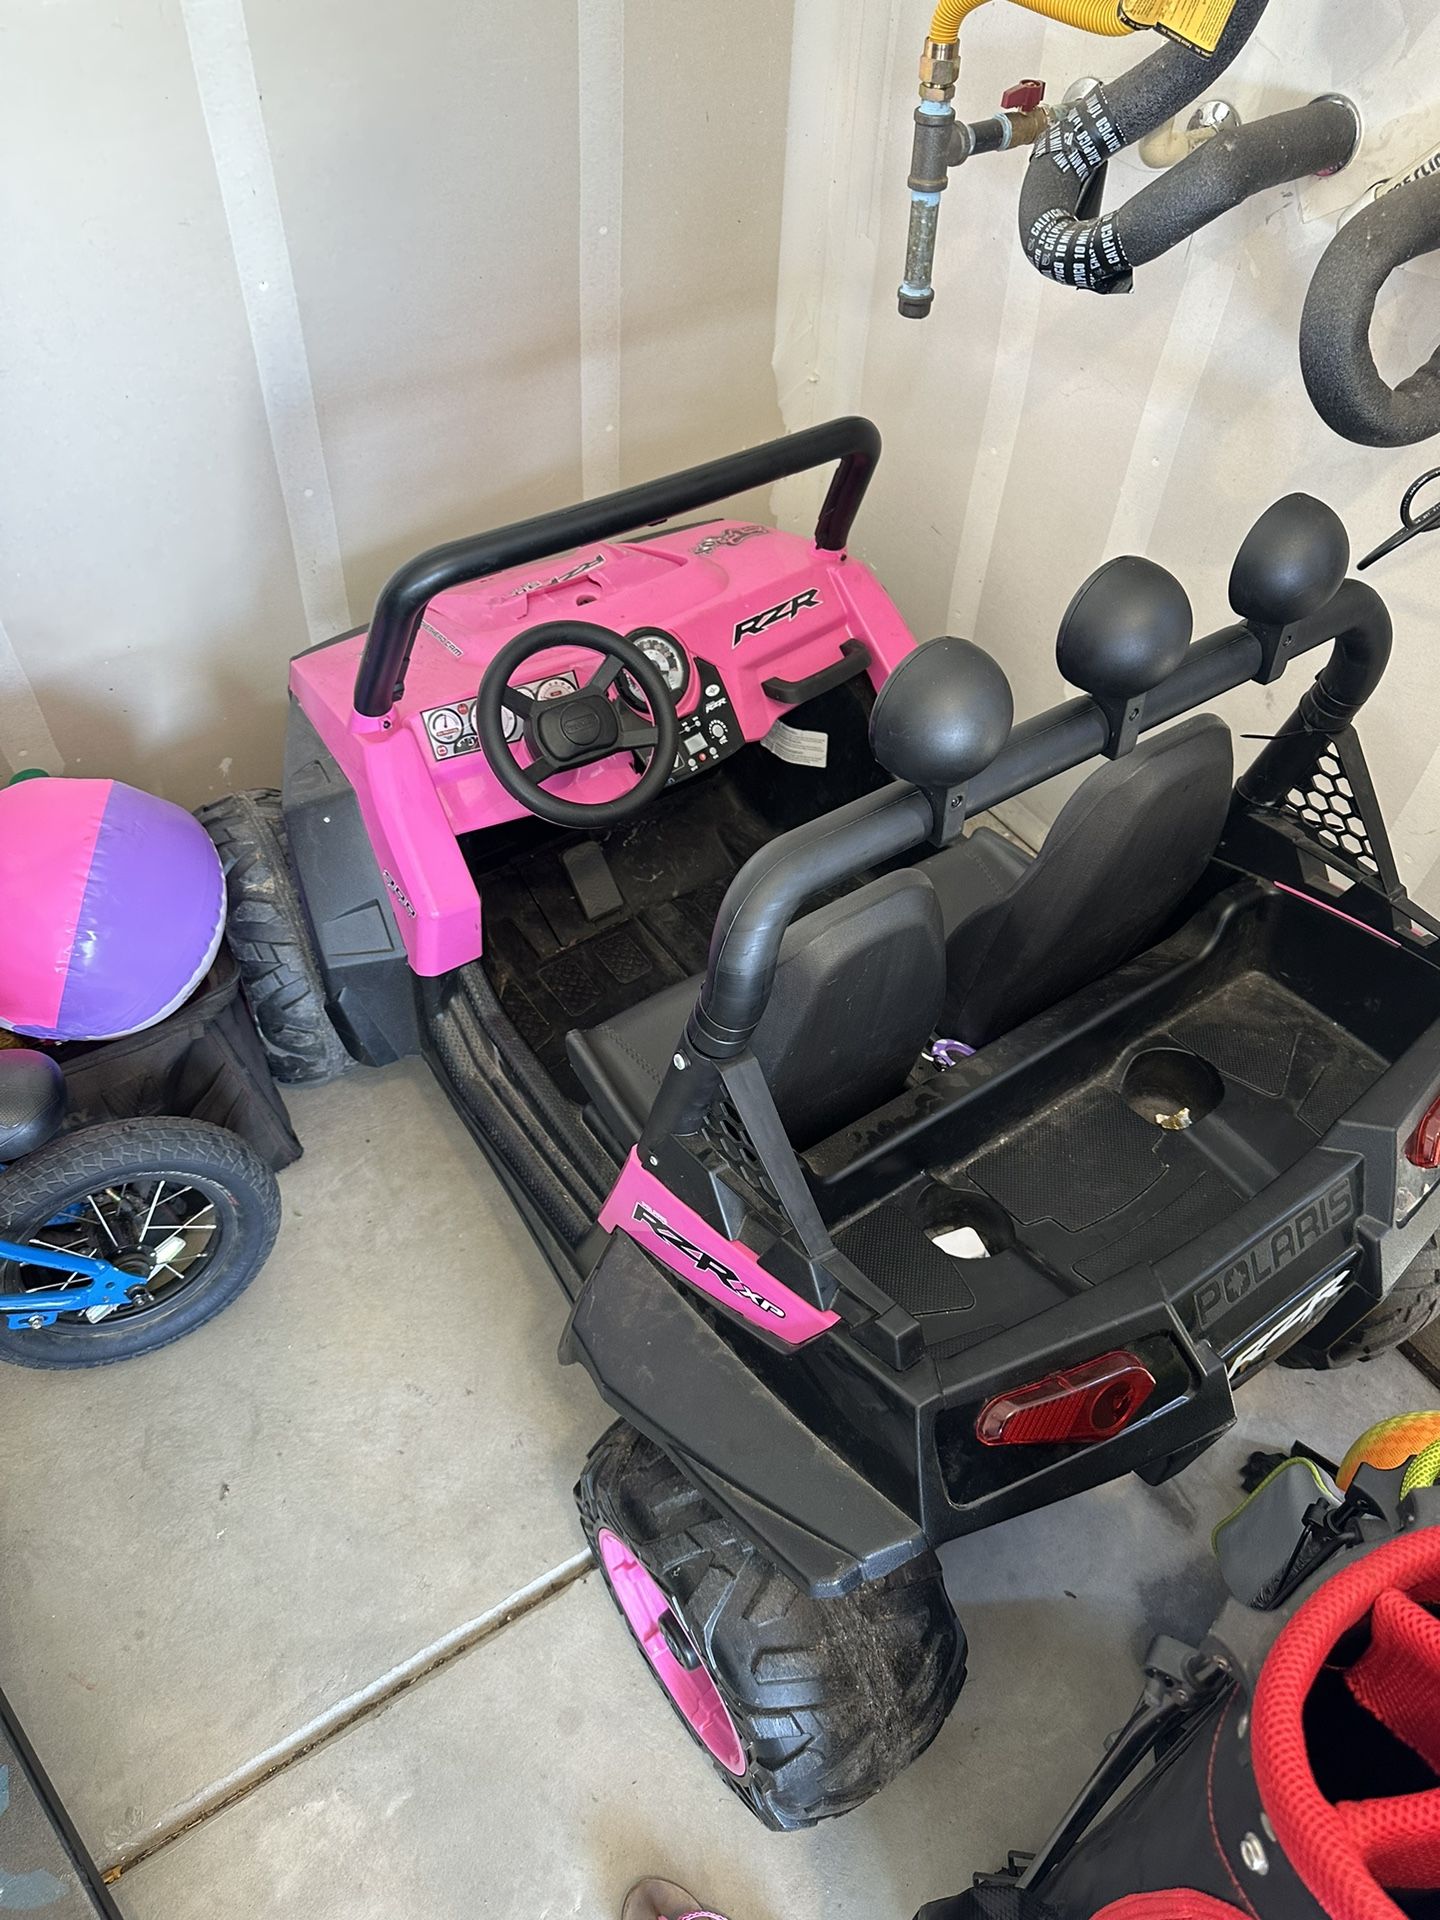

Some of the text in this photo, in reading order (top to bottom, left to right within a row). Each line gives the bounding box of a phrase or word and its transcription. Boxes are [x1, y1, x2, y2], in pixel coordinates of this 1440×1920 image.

[1076, 130, 1101, 166] CALPICO
[1095, 117, 1121, 153] CALPICO
[1101, 223, 1120, 264] CALPICO
[732, 587, 823, 649] RZR
[632, 1201, 787, 1319] RZR XP
[1193, 1177, 1354, 1331] POLARIS
